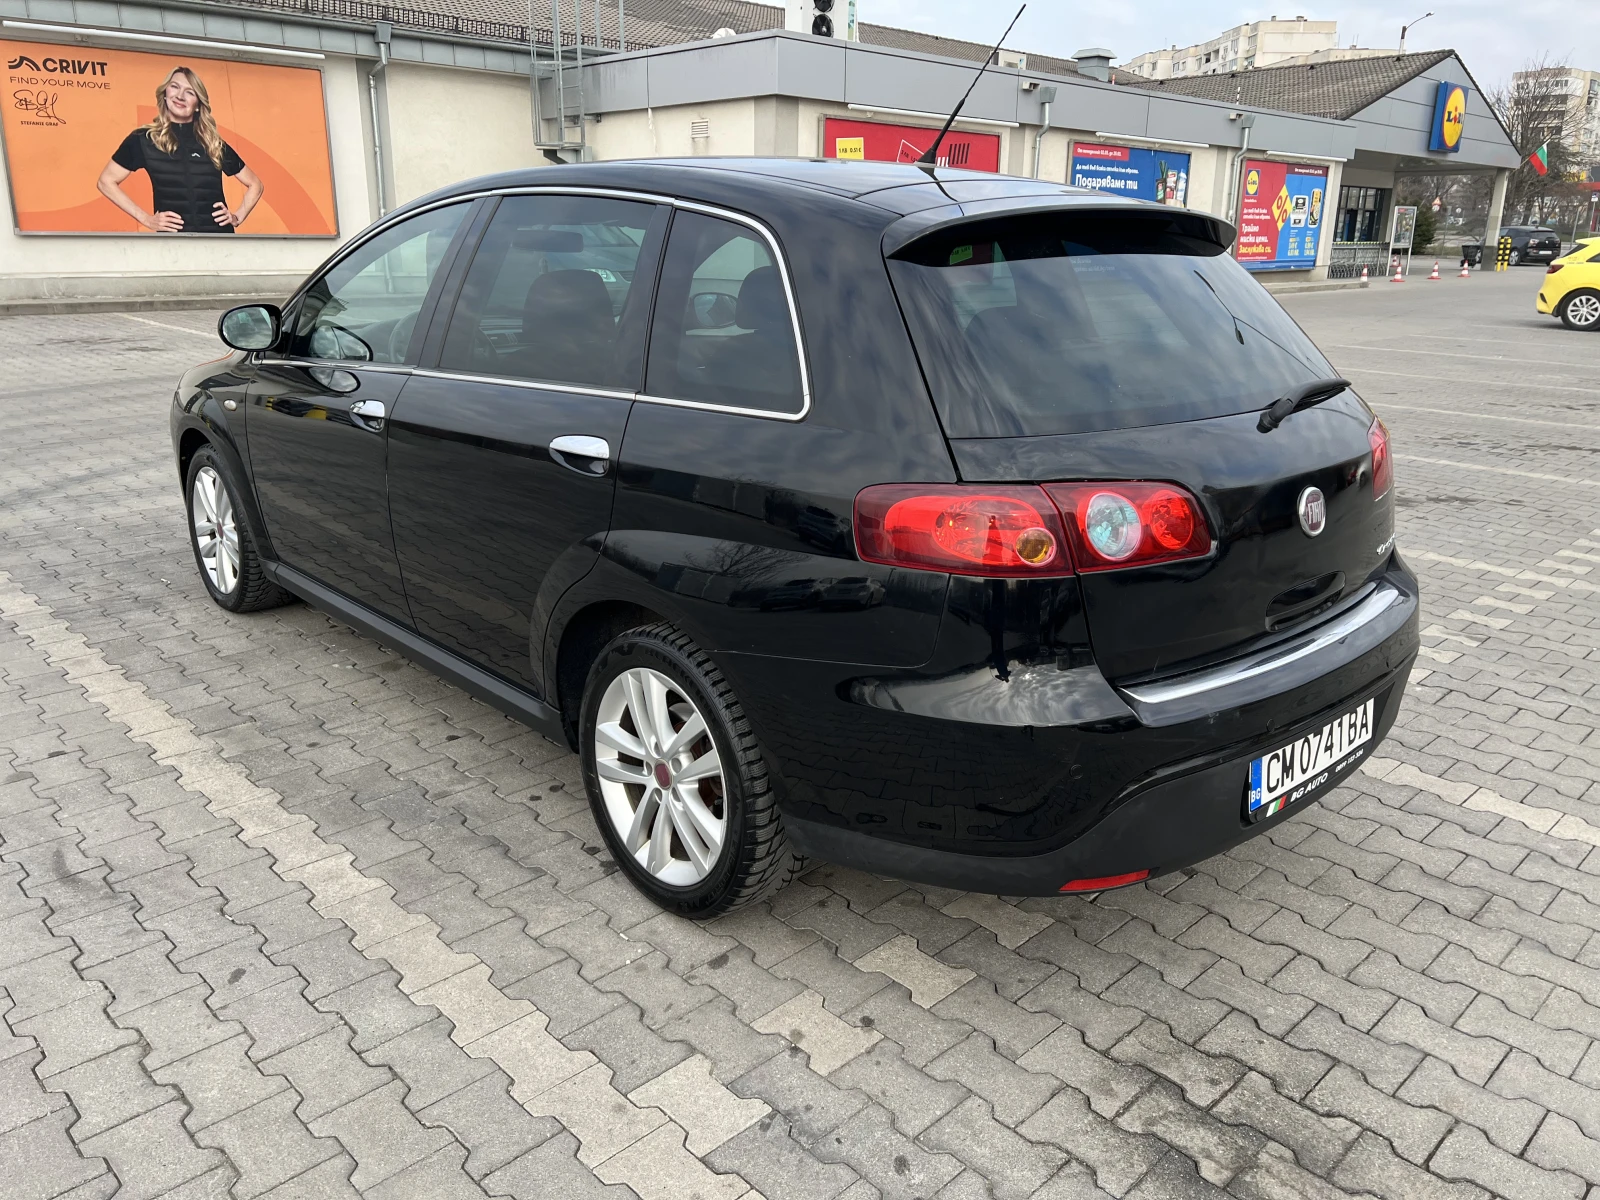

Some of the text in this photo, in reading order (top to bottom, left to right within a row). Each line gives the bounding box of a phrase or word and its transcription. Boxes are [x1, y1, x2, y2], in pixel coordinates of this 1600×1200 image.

[43, 57, 107, 76] CRIVIT
[10, 76, 111, 90] FIND YOUR MOVE
[1076, 174, 1138, 190] Подаряваме ти
[1308, 500, 1324, 525] FIAT
[1267, 703, 1369, 794] CM 0741 BA
[1251, 788, 1261, 803] BG
[1290, 772, 1328, 802] BG AUTO
